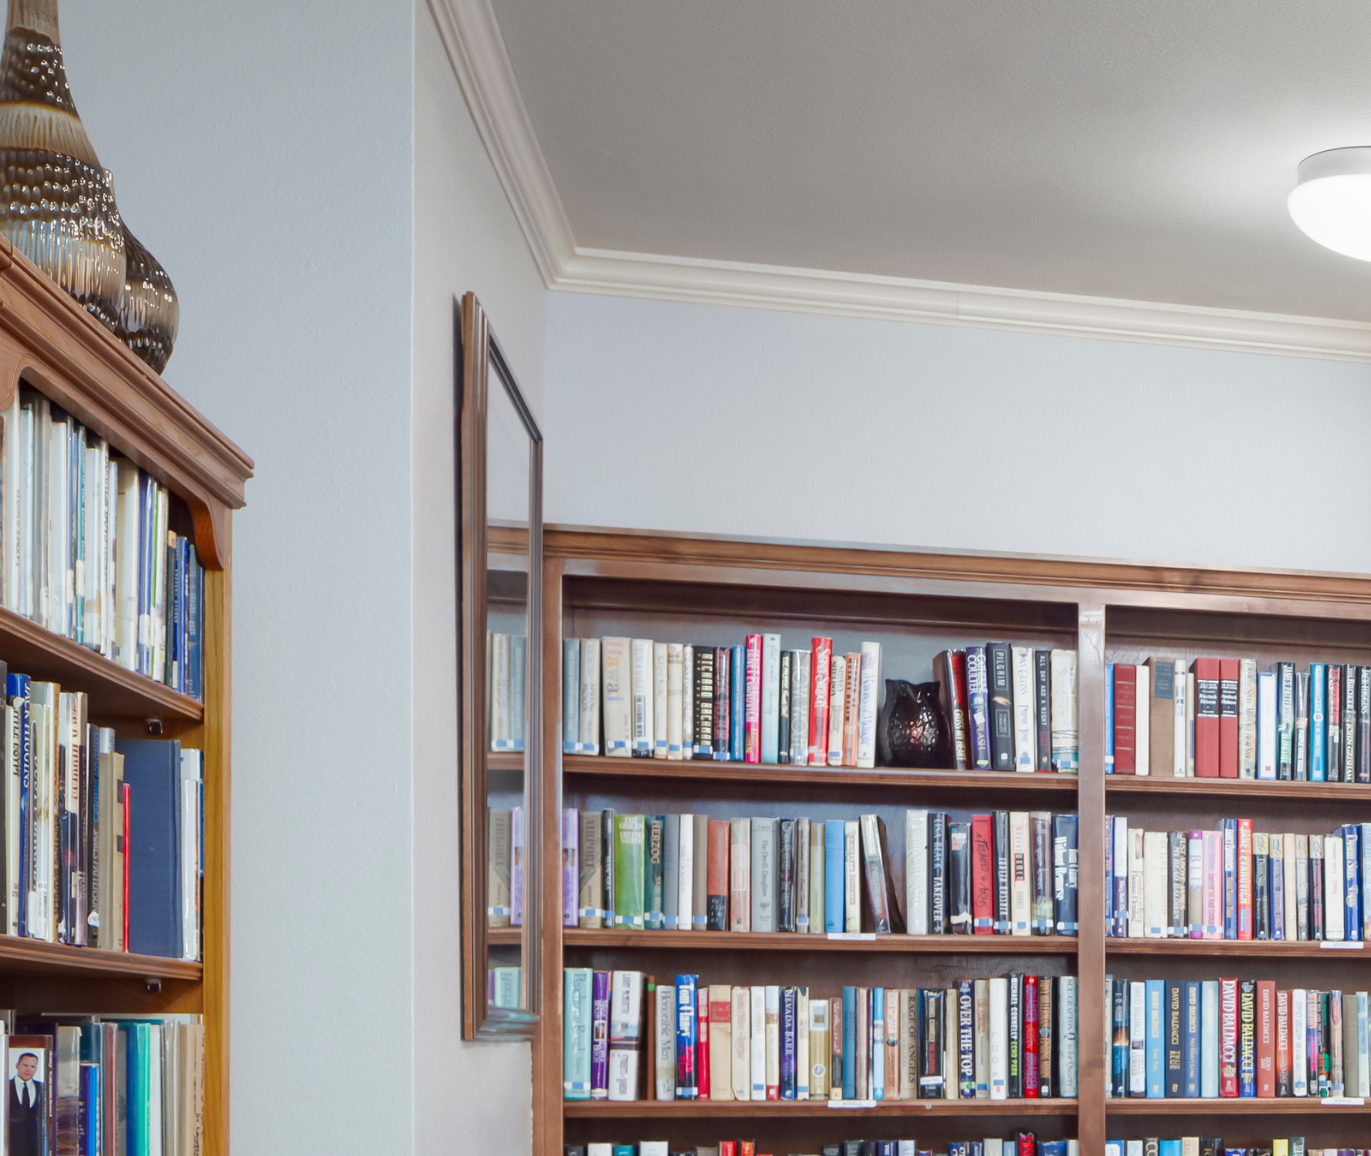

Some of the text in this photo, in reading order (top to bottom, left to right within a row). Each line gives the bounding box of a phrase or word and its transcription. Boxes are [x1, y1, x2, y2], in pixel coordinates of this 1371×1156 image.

[996, 652, 1005, 686] PILGRIM
[584, 818, 595, 869] AIRPORT
[651, 820, 662, 864] HERZOG
[934, 876, 943, 922] TAKEOVER
[661, 990, 672, 1060] Honorable Men
[676, 983, 694, 1038] Tom Clancy
[960, 995, 973, 1076] OVER THE TOP
[1222, 980, 1236, 1064] DAVID BALDACCI
[908, 995, 916, 1083] RAGE OF ANGELS
